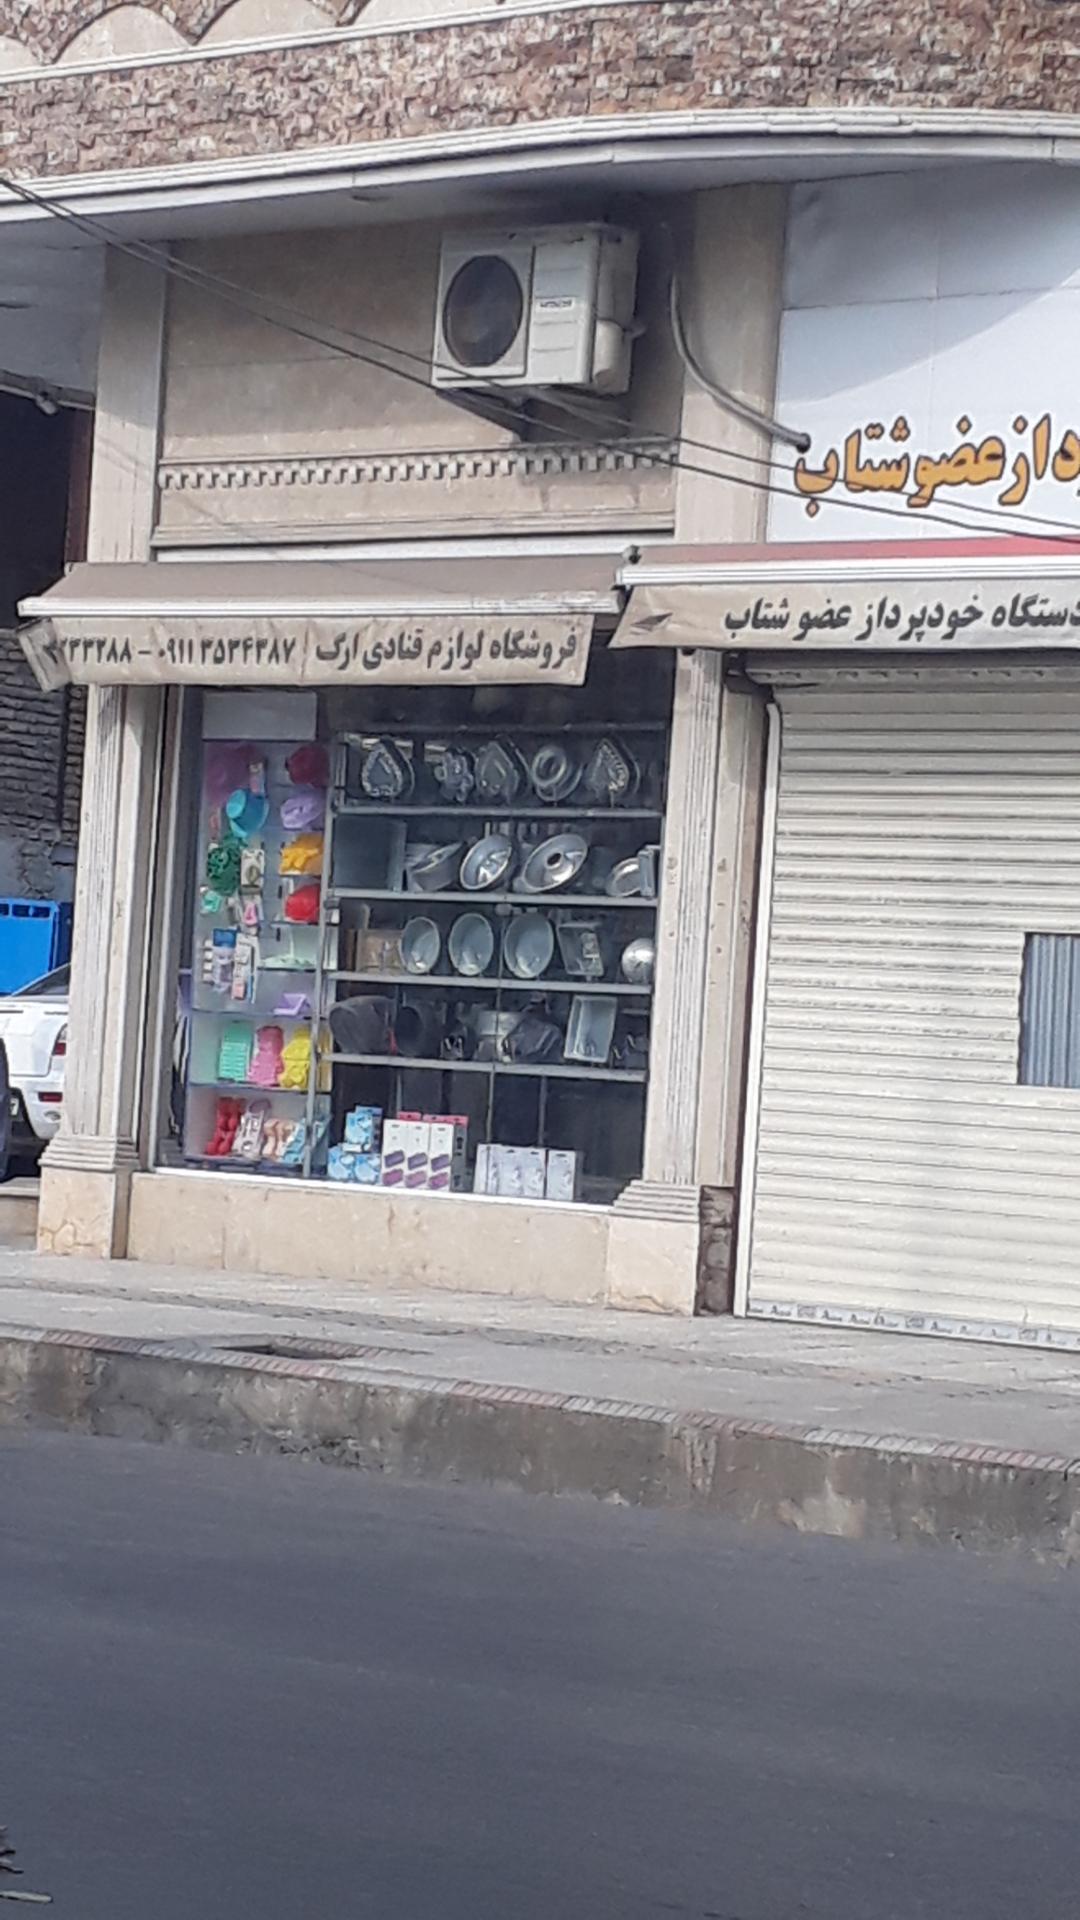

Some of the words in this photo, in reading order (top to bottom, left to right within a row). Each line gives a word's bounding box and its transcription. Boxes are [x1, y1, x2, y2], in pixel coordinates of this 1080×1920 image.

[794, 415, 911, 518] شتاب
[907, 414, 1006, 508] عضو
[998, 412, 1080, 506] داز
[724, 597, 790, 639] شتاب
[792, 598, 852, 641] عضو
[362, 627, 423, 671] قنادی
[426, 629, 484, 670] لوازم
[489, 627, 577, 669] فروشگاه
